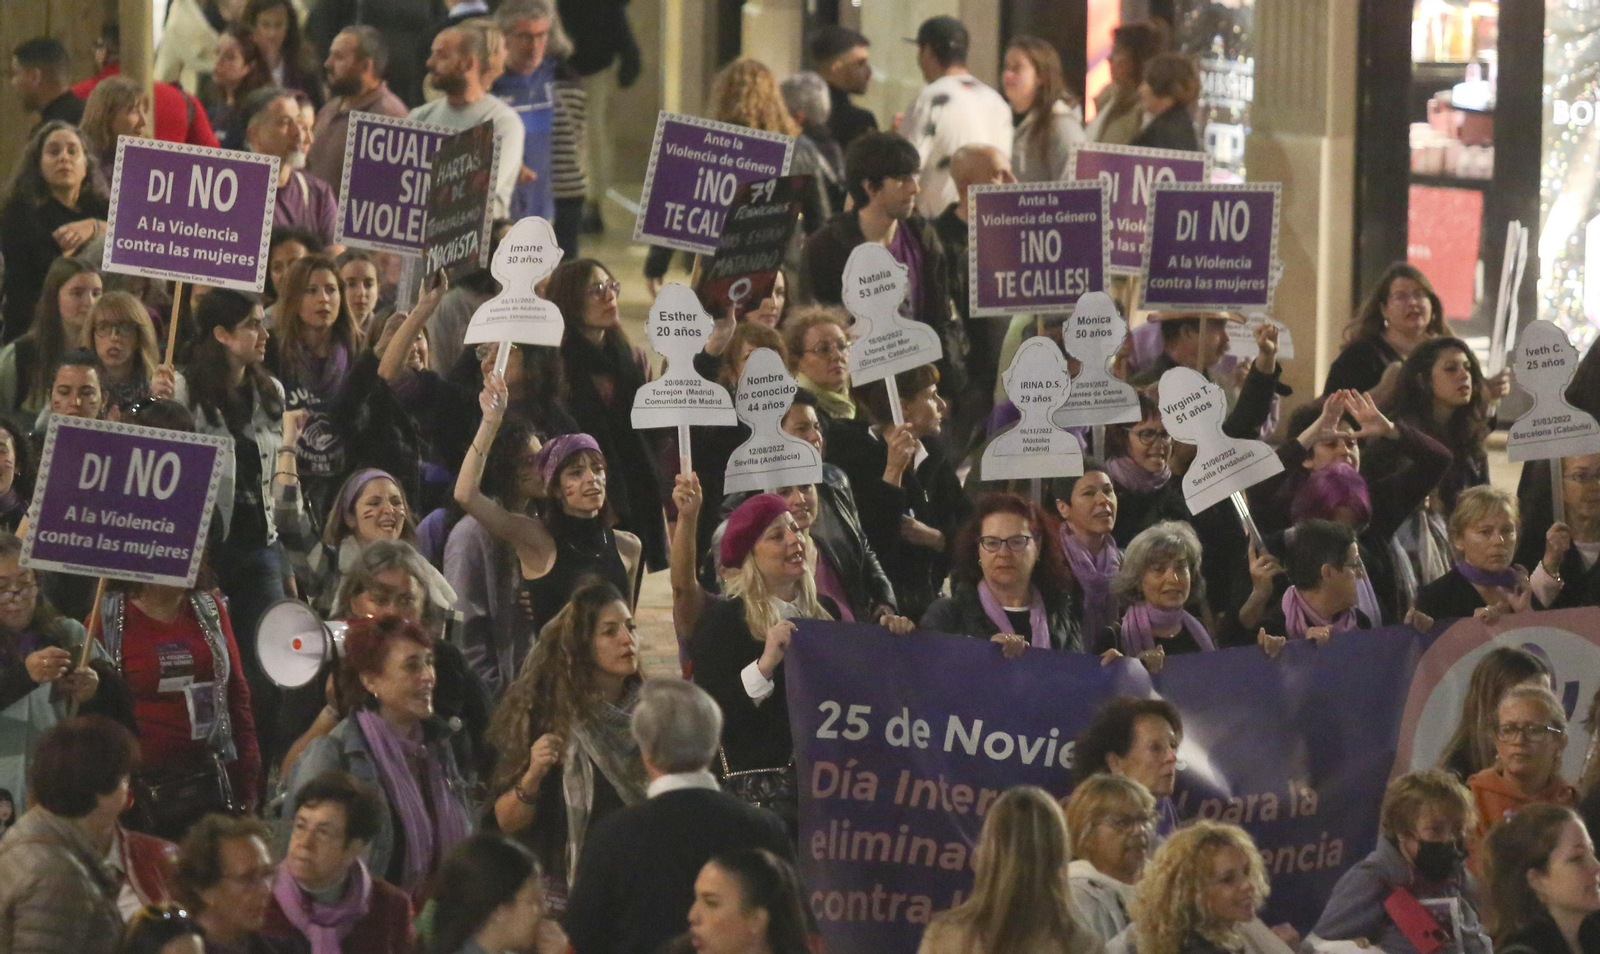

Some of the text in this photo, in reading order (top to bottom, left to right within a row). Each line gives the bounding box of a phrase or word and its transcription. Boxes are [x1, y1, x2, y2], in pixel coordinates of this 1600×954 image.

[703, 132, 744, 151] Ante la
[666, 142, 777, 176] Violencia de Género
[437, 153, 481, 187] HARTAS
[146, 164, 239, 213] DI NO
[693, 167, 738, 206] ¡NO
[751, 179, 777, 204] 79
[1018, 193, 1060, 207] Ante la
[664, 201, 686, 231] TE
[982, 210, 1097, 227] Violencia de Género
[1176, 200, 1250, 242] DI NO
[136, 216, 239, 243] A la Violencia
[116, 236, 255, 267] contra las mujeres
[509, 243, 543, 254] Imane
[1020, 229, 1062, 264] ¡NO
[1117, 237, 1137, 252] las
[506, 254, 543, 265] 30 años
[1168, 254, 1252, 270] A la Violencia
[858, 270, 892, 285] Natalia
[995, 267, 1090, 299] TE CALLES!
[1150, 275, 1266, 292] contra las mujeres
[859, 281, 897, 299] 53 años
[658, 311, 698, 322] Esther
[1077, 315, 1111, 326] Mónica
[656, 326, 702, 338] 20 años
[1075, 328, 1112, 339] 50 años
[865, 345, 886, 356] Lloret
[1525, 343, 1564, 357] Iveth C.
[1526, 357, 1566, 370] 25 años
[746, 373, 784, 386] Nombre
[1020, 380, 1062, 390] IRINA D.S.
[651, 389, 715, 397] Torrejón (Madrid)
[738, 385, 796, 401] no conocido
[1020, 393, 1052, 404] 29 años
[1163, 385, 1212, 415] Virginia T.
[747, 400, 785, 412] 44 años
[1175, 400, 1213, 425] 51 años
[1532, 415, 1572, 427] 21/03/2022
[1513, 422, 1592, 440] Barcelona (Cataluña)
[1022, 436, 1050, 444] Móstoles
[748, 444, 785, 455] 12/08/2022
[734, 457, 759, 467] Sevilla
[78, 447, 182, 500] DI NO
[1192, 470, 1217, 487] Sevilla
[64, 506, 175, 534] A la Violencia
[38, 530, 190, 560] contra las mujeres
[816, 700, 872, 742] 25
[884, 706, 931, 749] de
[811, 759, 879, 802] Día
[1197, 792, 1280, 824] para
[1288, 778, 1319, 818] la
[810, 883, 932, 924] contra
